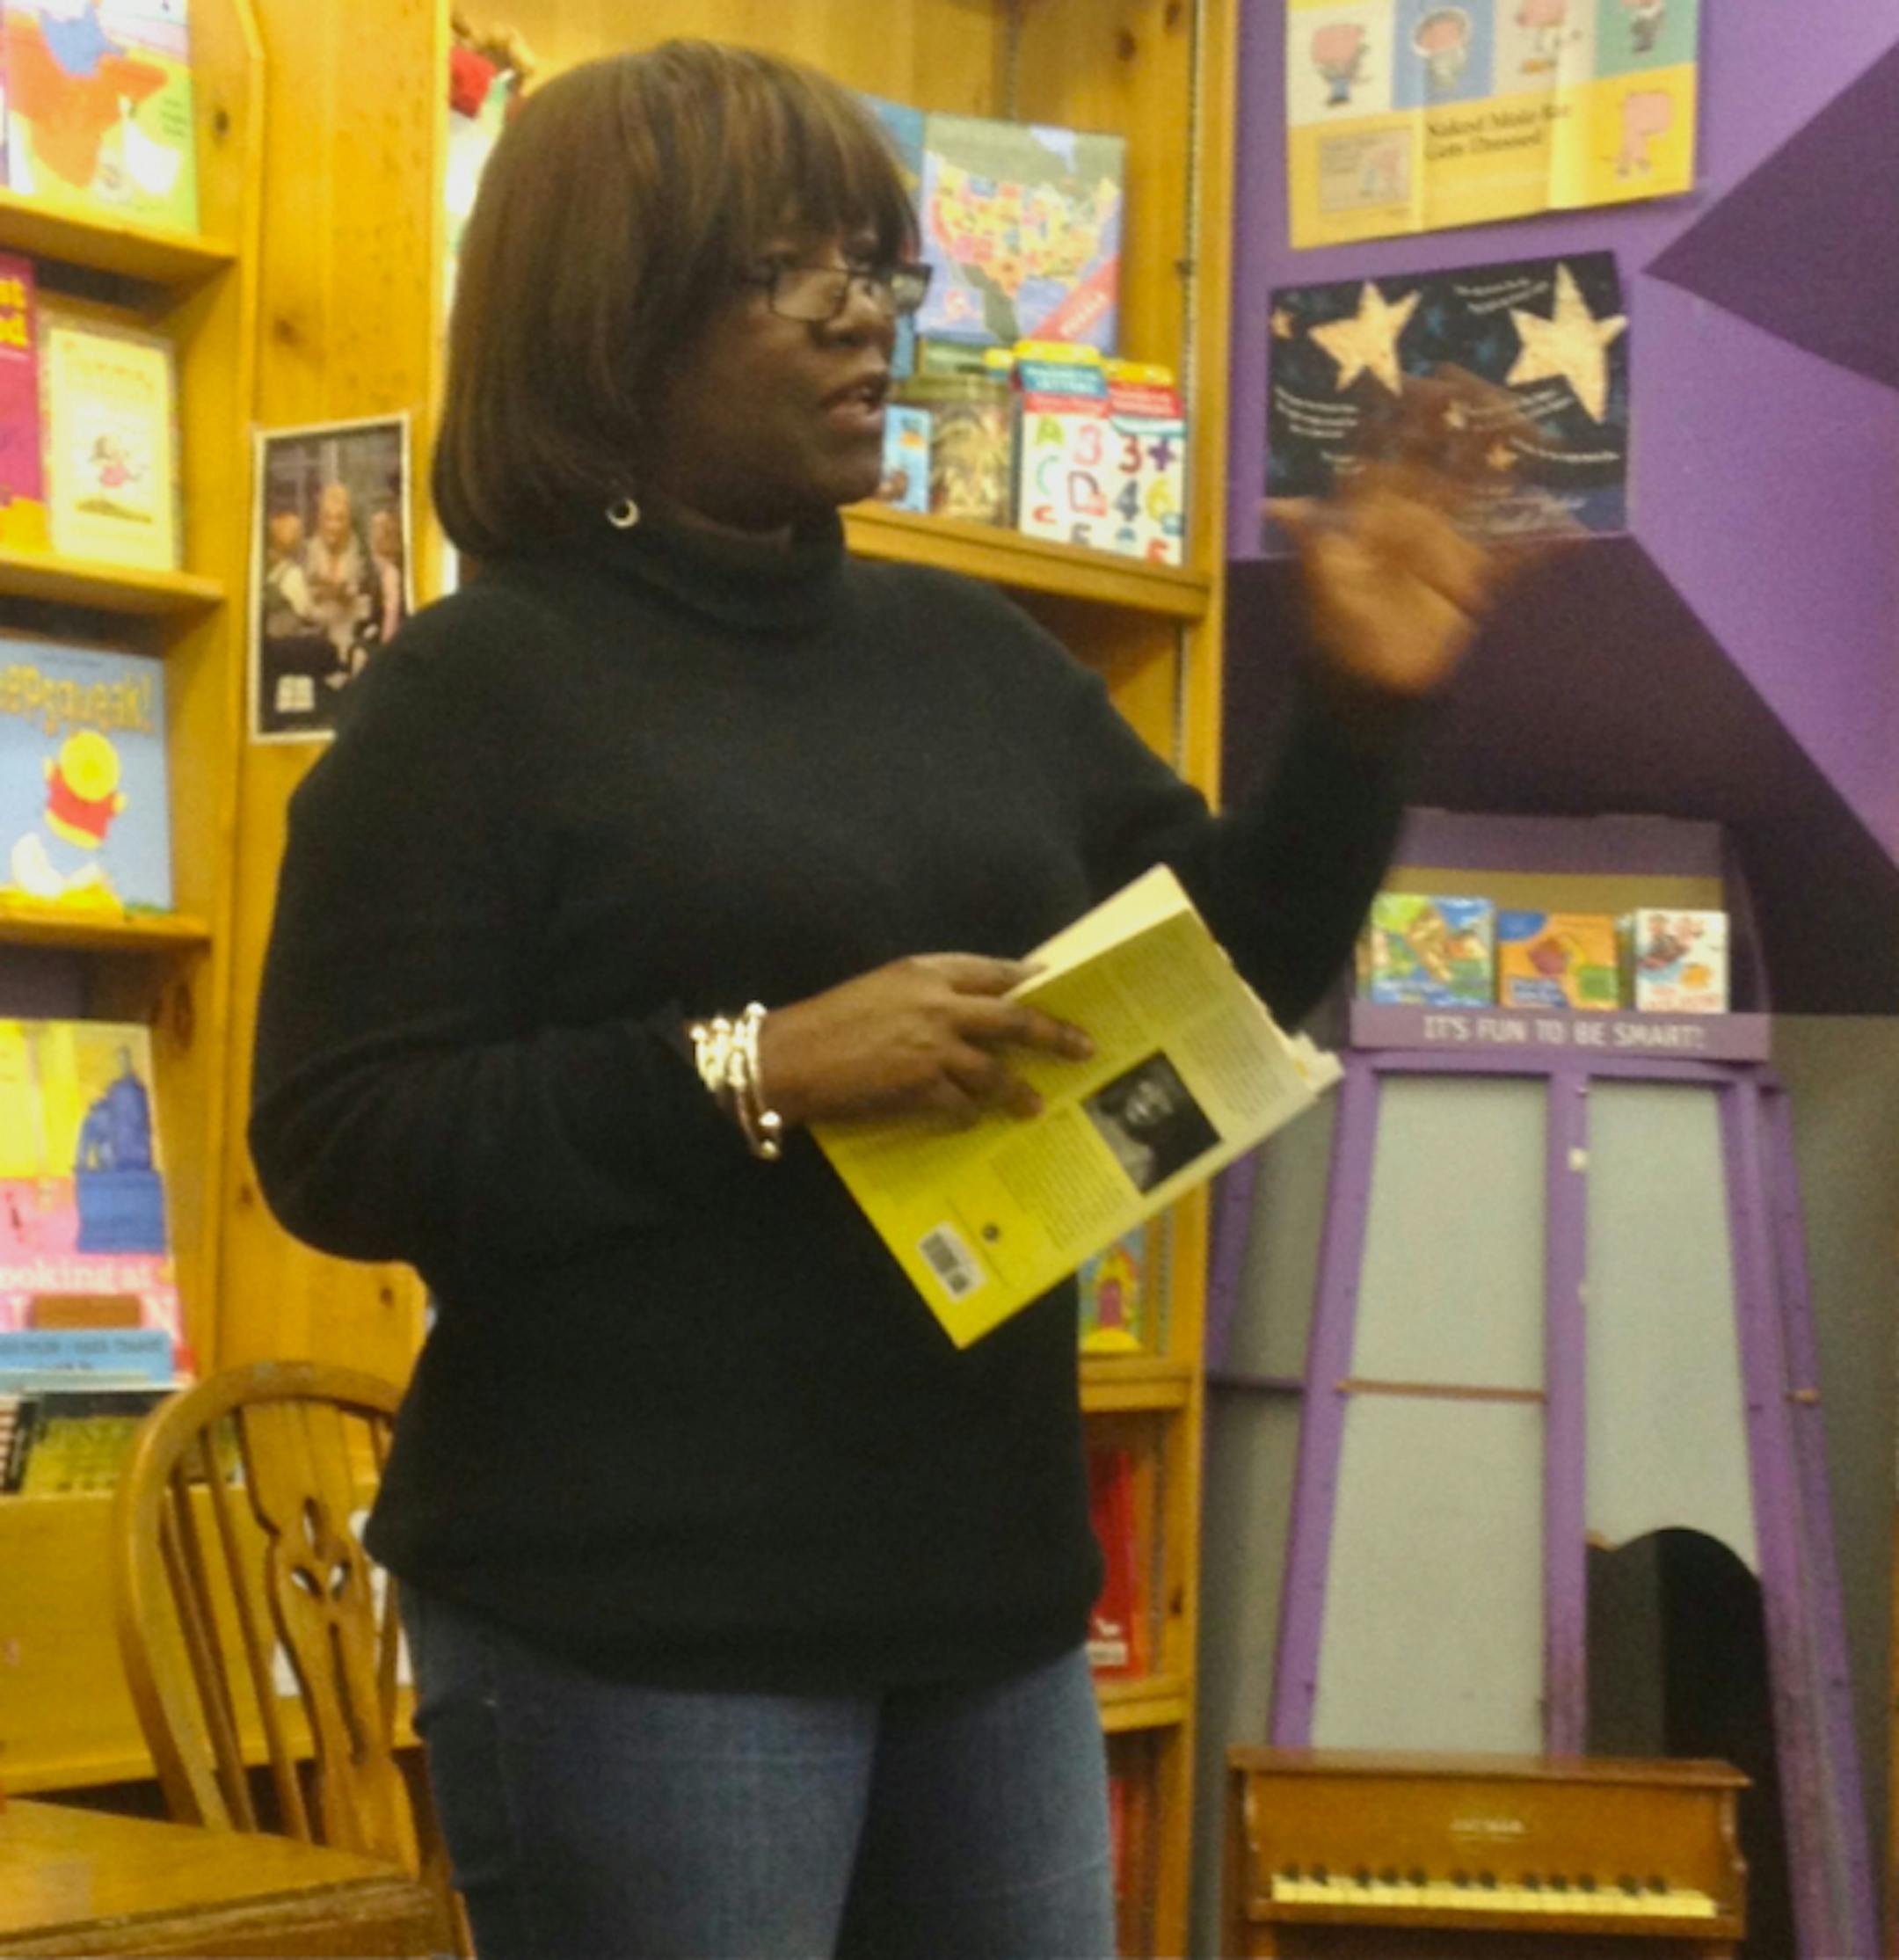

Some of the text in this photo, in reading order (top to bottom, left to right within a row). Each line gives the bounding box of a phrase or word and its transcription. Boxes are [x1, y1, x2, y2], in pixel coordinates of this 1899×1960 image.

[1422, 1015, 1471, 1041] IT'S
[1477, 1017, 1527, 1043] FUN
[1535, 1018, 1565, 1044] TO
[1573, 1020, 1606, 1046] BE
